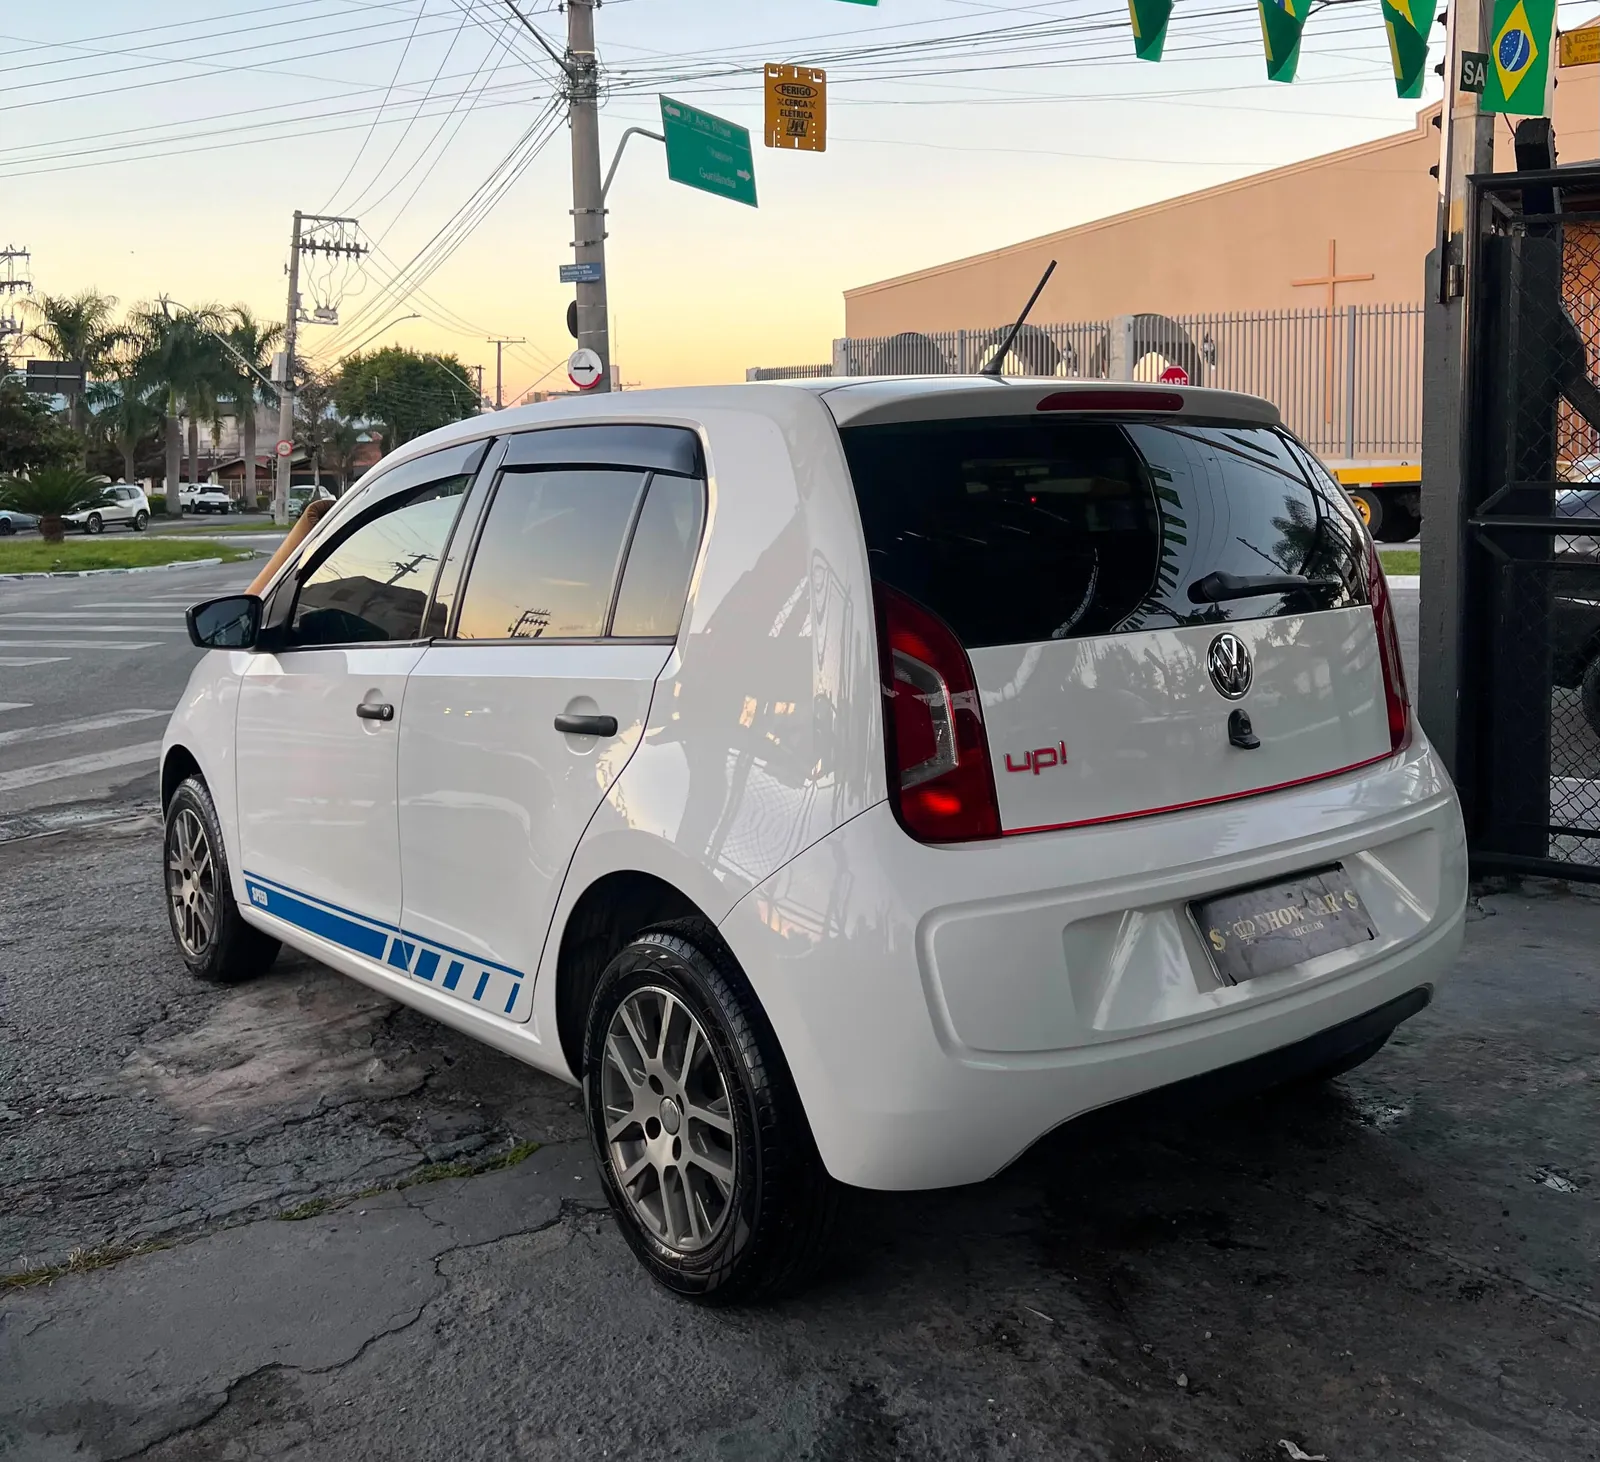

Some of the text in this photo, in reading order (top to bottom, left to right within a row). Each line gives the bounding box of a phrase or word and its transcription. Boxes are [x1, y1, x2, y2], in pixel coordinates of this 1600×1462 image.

[781, 85, 811, 96] PERIGO
[785, 98, 808, 107] CERCA
[780, 108, 813, 119] ELÉTRICA
[1004, 740, 1068, 775] up!
[1254, 904, 1304, 935] SHOW
[1307, 891, 1342, 917] CAR
